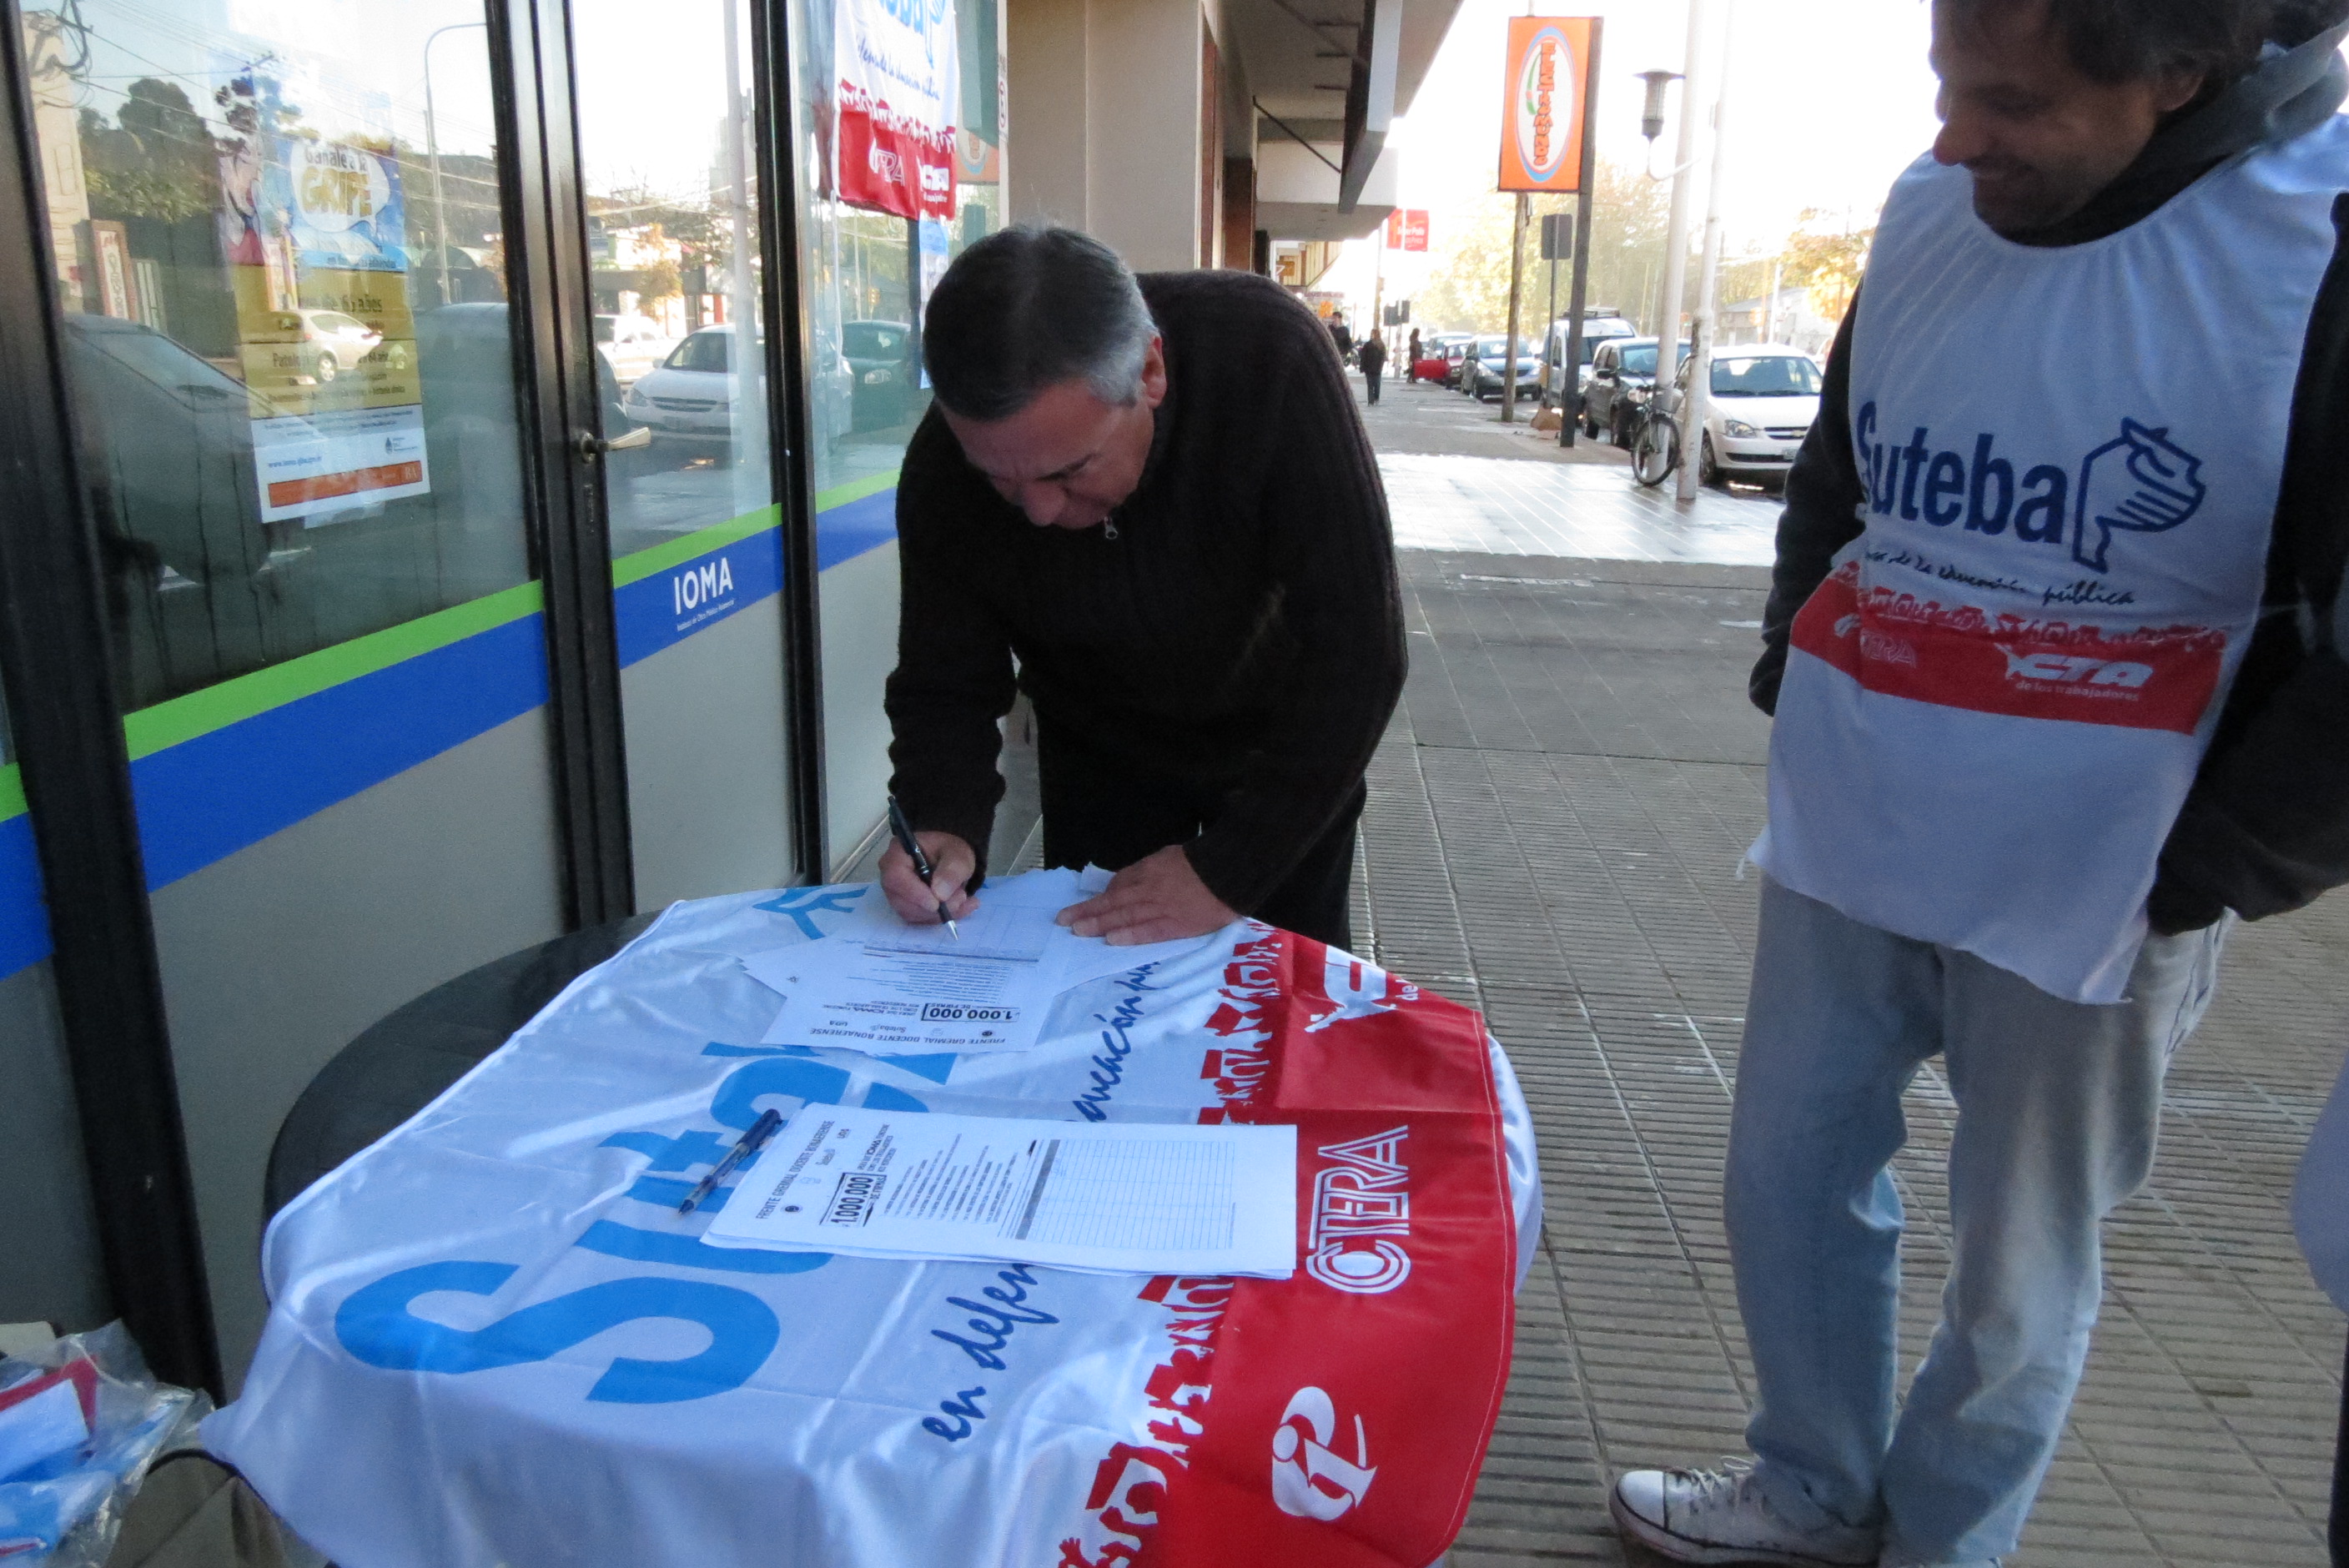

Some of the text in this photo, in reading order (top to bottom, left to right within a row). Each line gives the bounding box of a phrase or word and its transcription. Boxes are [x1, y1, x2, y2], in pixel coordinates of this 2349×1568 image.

[1532, 43, 1556, 166] ELECTROMUNDO
[1857, 401, 2068, 544] Suteba
[673, 556, 734, 616] IOMA
[809, 1028, 1006, 1045] FRENTE GREMIAL DOCENTE BONAERENSE
[928, 1007, 1014, 1020] 1.000.000
[756, 1120, 835, 1219] FRENTE GREMIAL DOCENTE BONAERENSE
[831, 1177, 874, 1224] 1.000.000
[1305, 1123, 1411, 1294] CTERA
[930, 1263, 1060, 1371] defen
[922, 1386, 987, 1442] en
